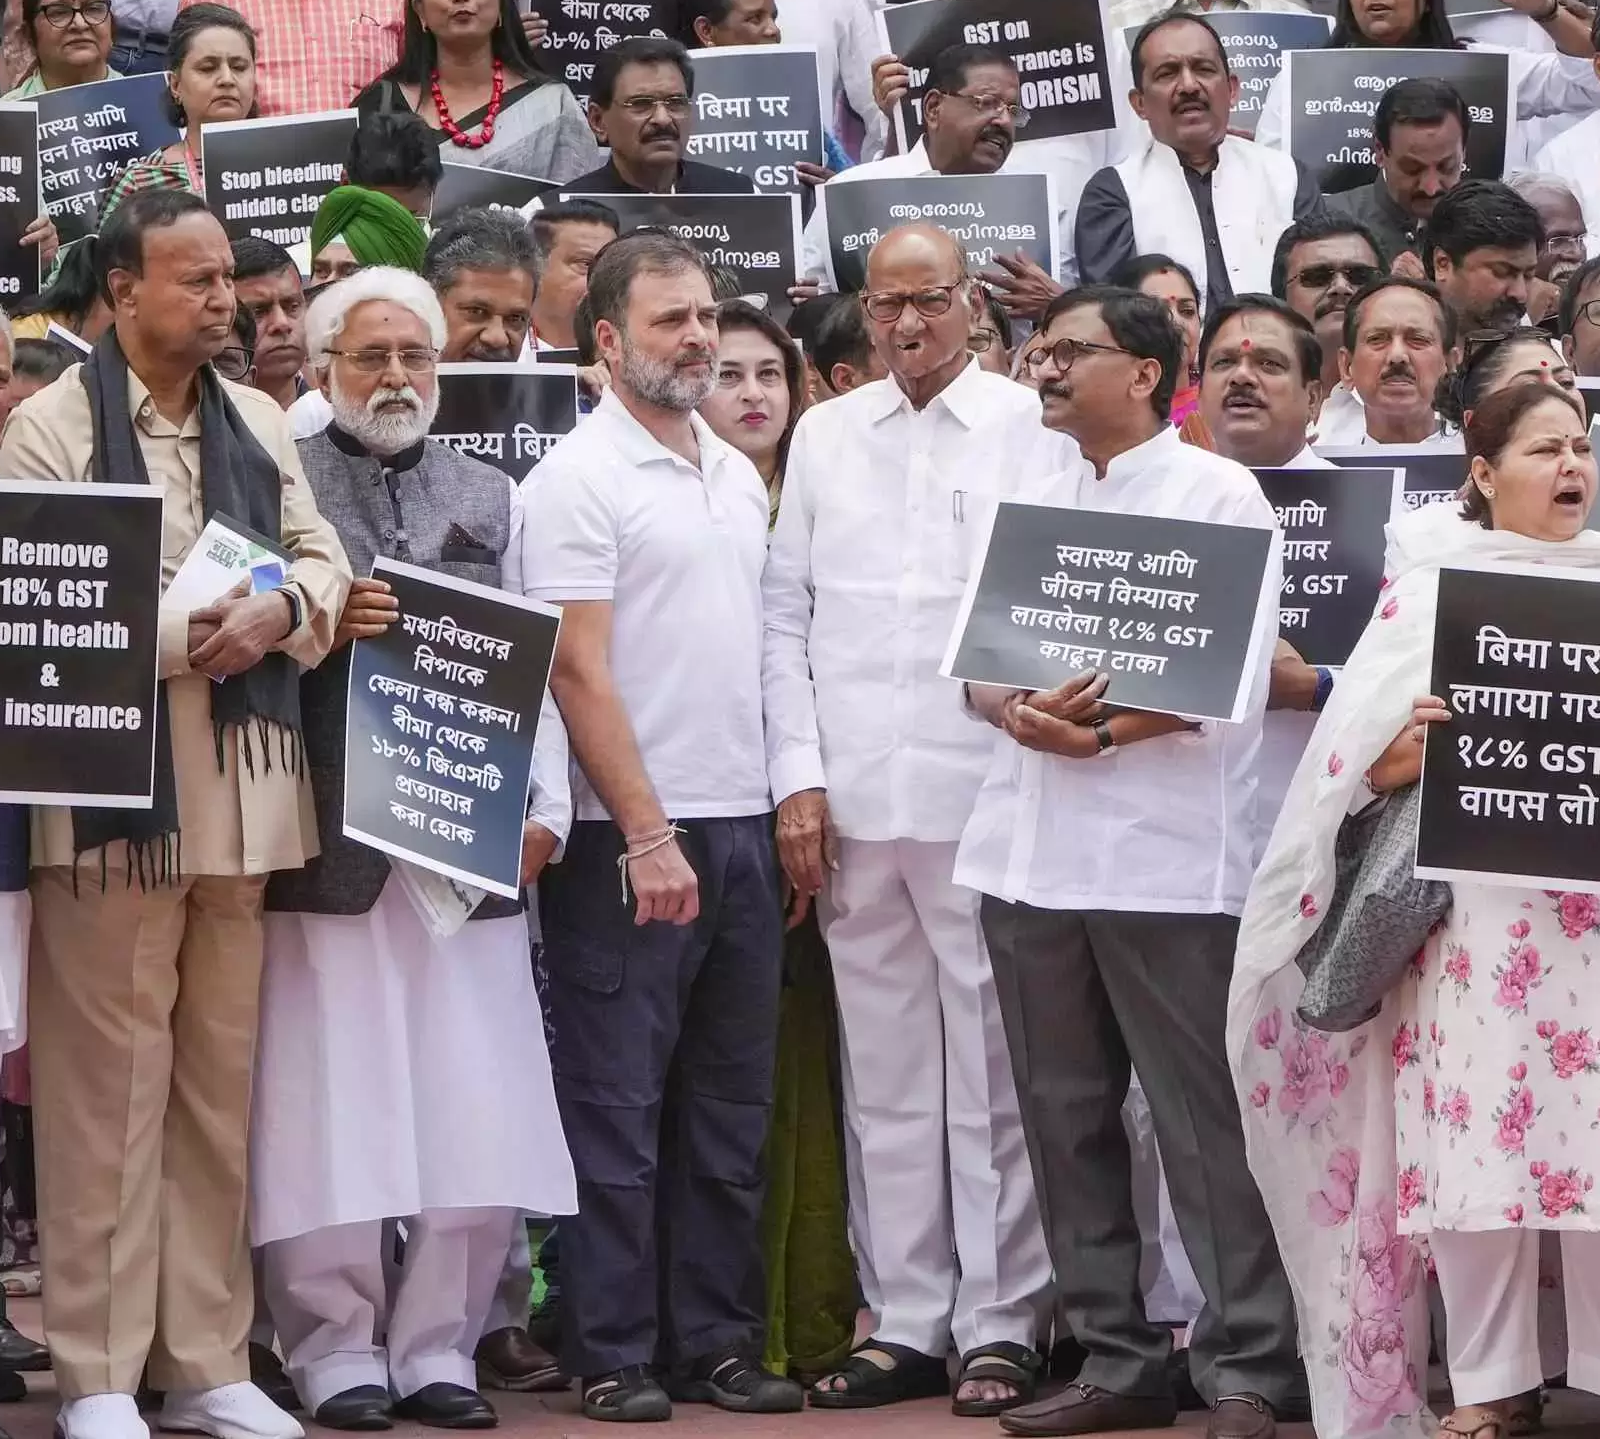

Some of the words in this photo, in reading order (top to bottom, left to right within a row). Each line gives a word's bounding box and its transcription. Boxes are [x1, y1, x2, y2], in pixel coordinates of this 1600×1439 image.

[603, 3, 652, 22] থেকে
[1475, 624, 1553, 670] बिमा
[1449, 683, 1553, 720] लगाया
[1457, 734, 1528, 769] १८%
[1458, 785, 1549, 821] वापस
[1556, 783, 1600, 826] लो
